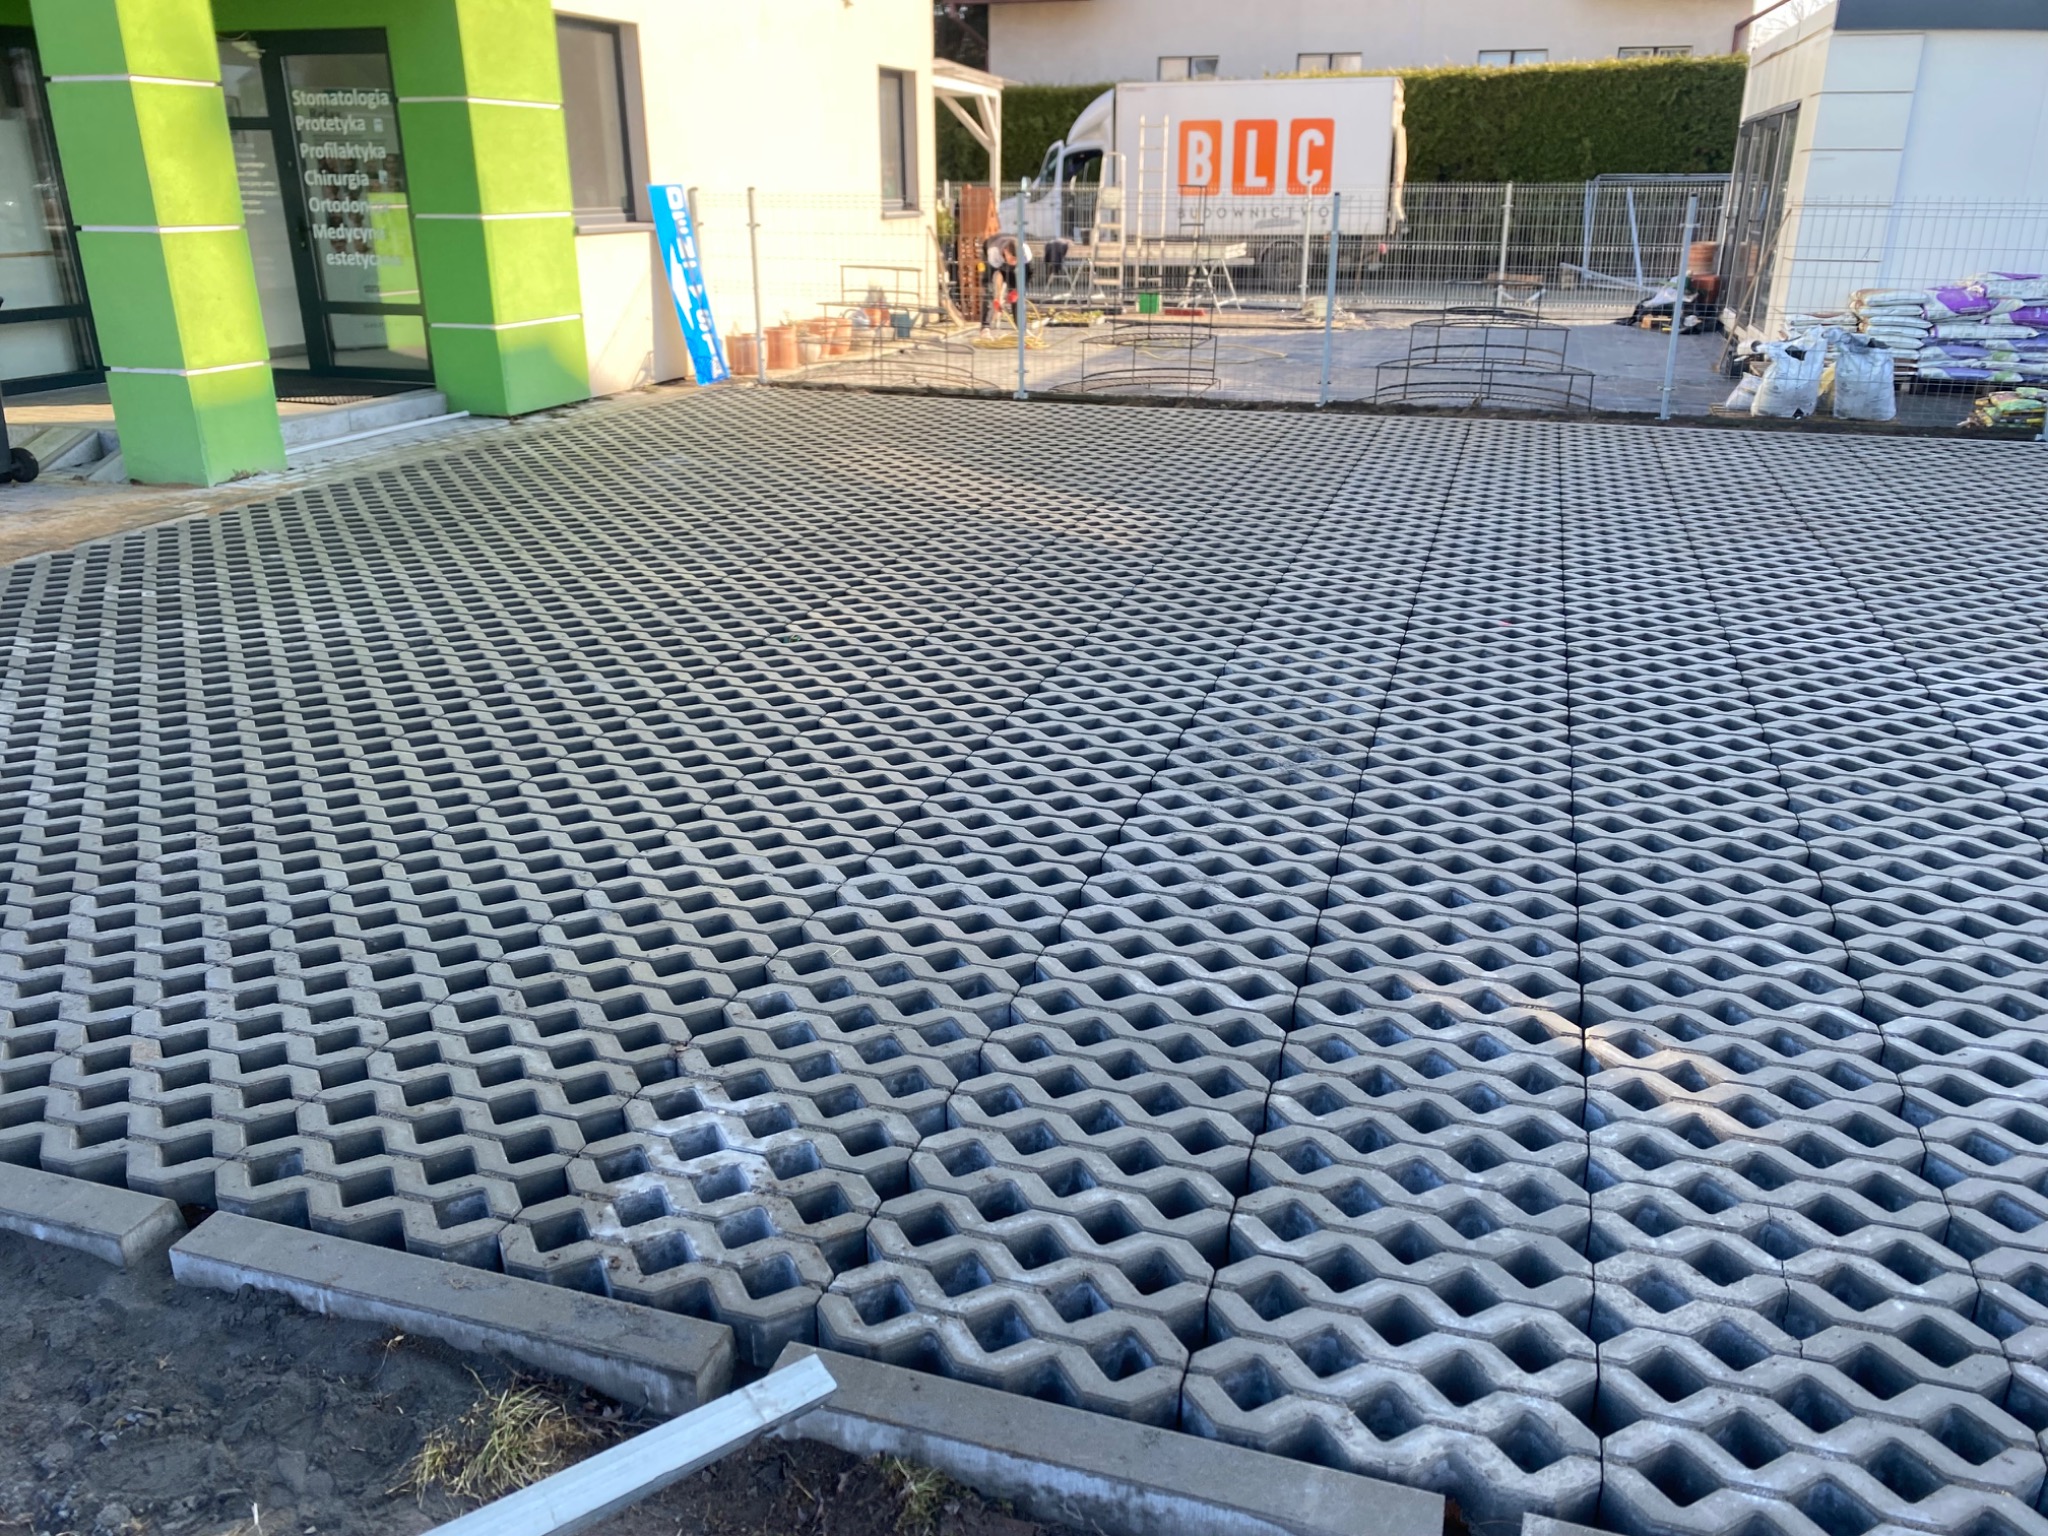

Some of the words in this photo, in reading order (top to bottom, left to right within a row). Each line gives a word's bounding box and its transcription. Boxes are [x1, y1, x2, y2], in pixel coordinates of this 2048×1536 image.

[291, 88, 389, 110] Stomatologia
[295, 114, 367, 135] Protetyka
[299, 141, 387, 163] Profilaktyka
[1186, 128, 1326, 188] BLC
[304, 169, 370, 190] Chirurgia
